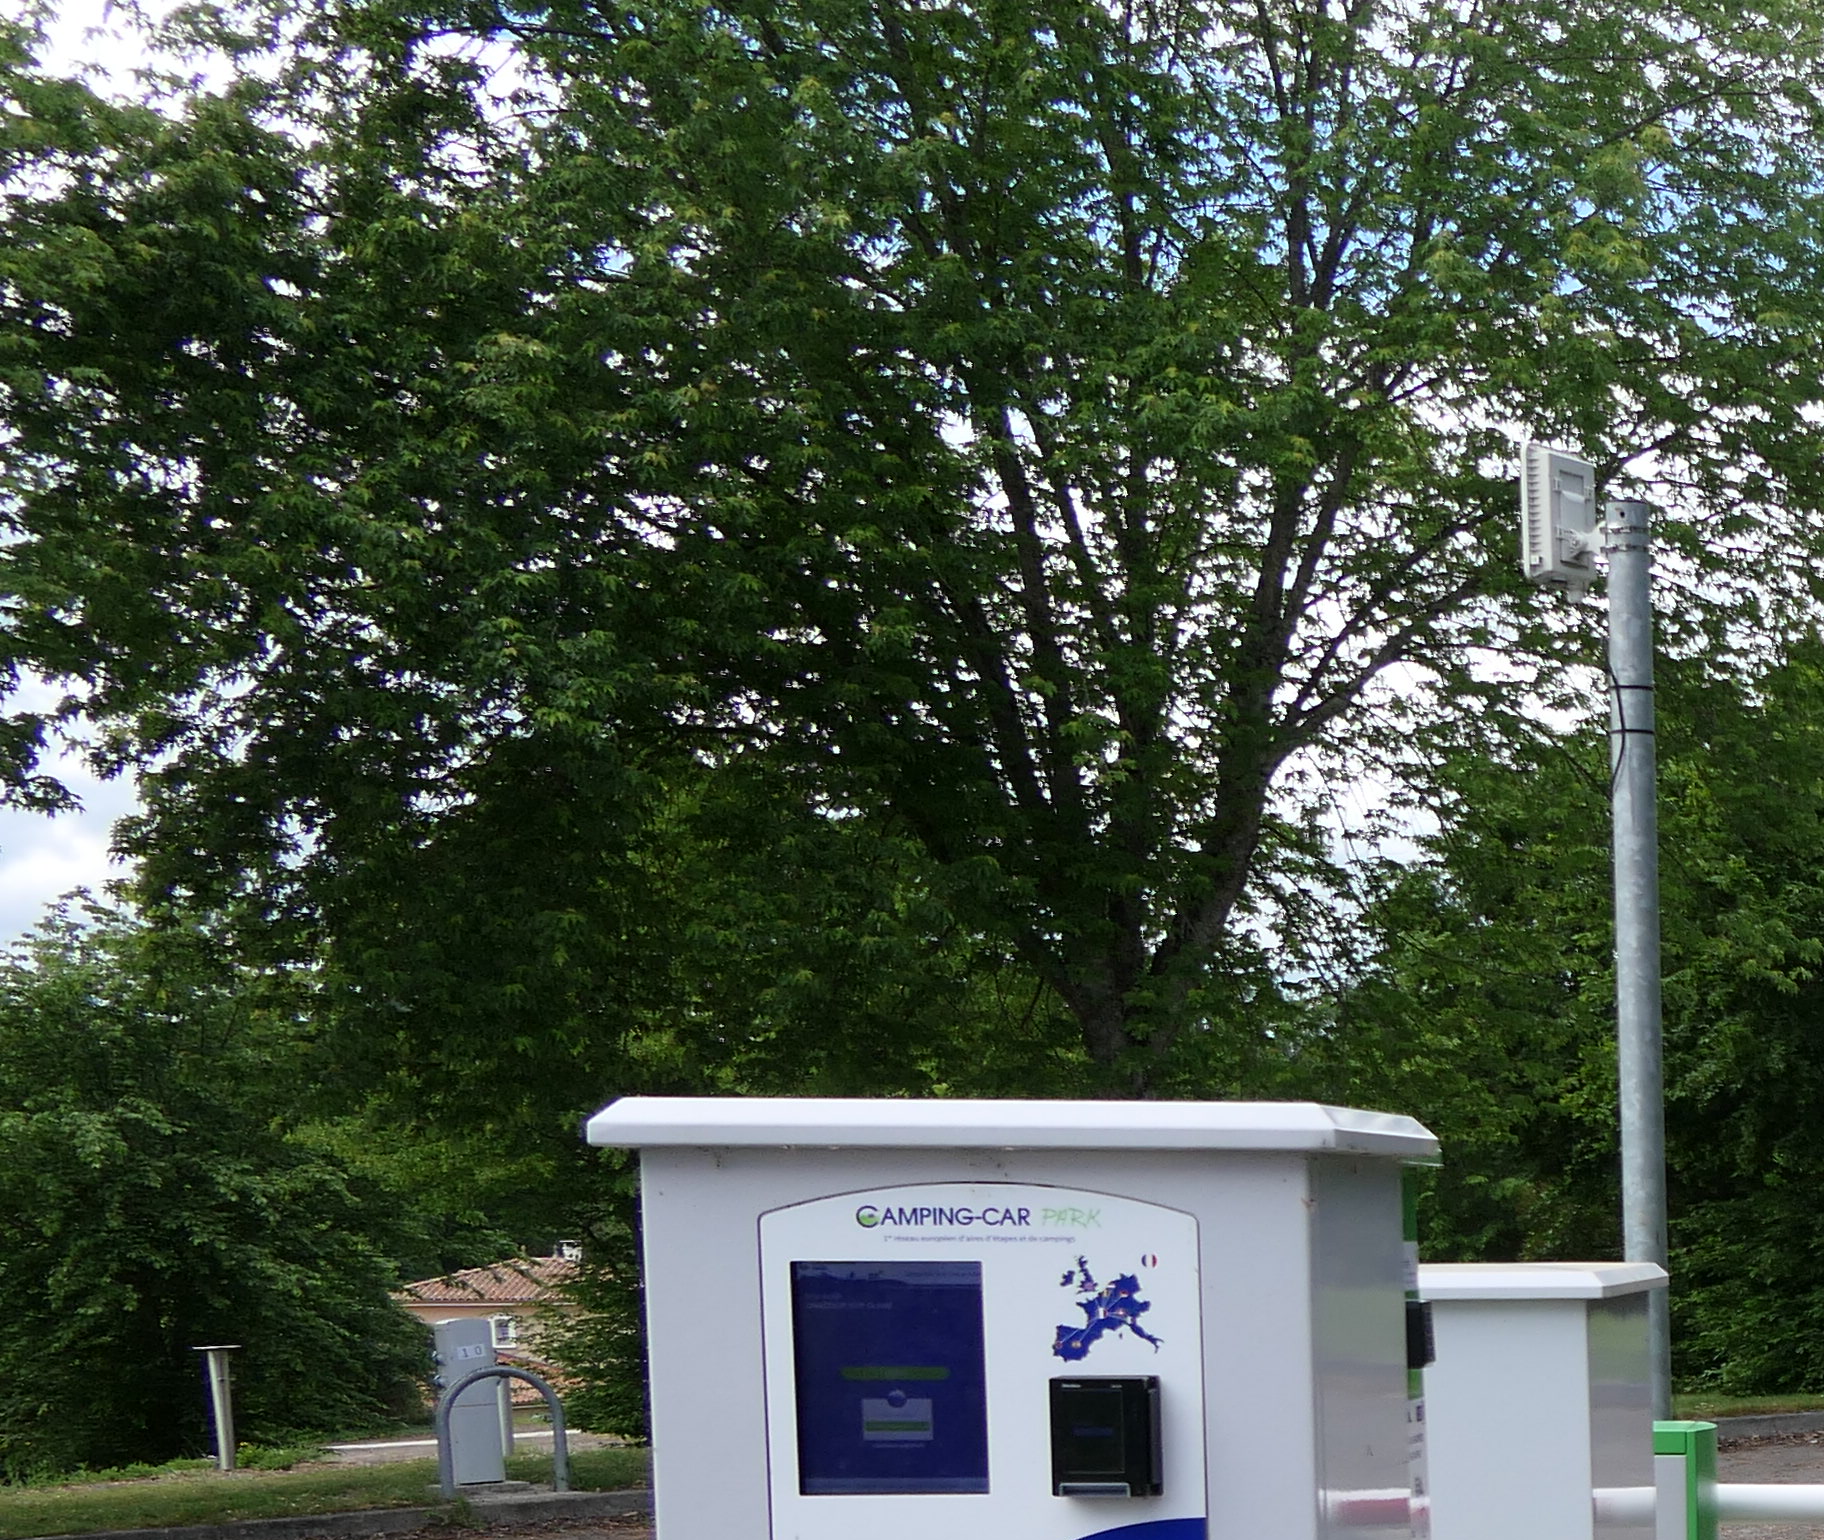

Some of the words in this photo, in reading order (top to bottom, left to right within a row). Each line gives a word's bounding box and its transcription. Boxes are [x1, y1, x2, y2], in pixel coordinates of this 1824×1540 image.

[856, 1205, 1031, 1229] CAMPING-CAR
[1041, 1207, 1102, 1228] PARK
[462, 1346, 482, 1358] 10
